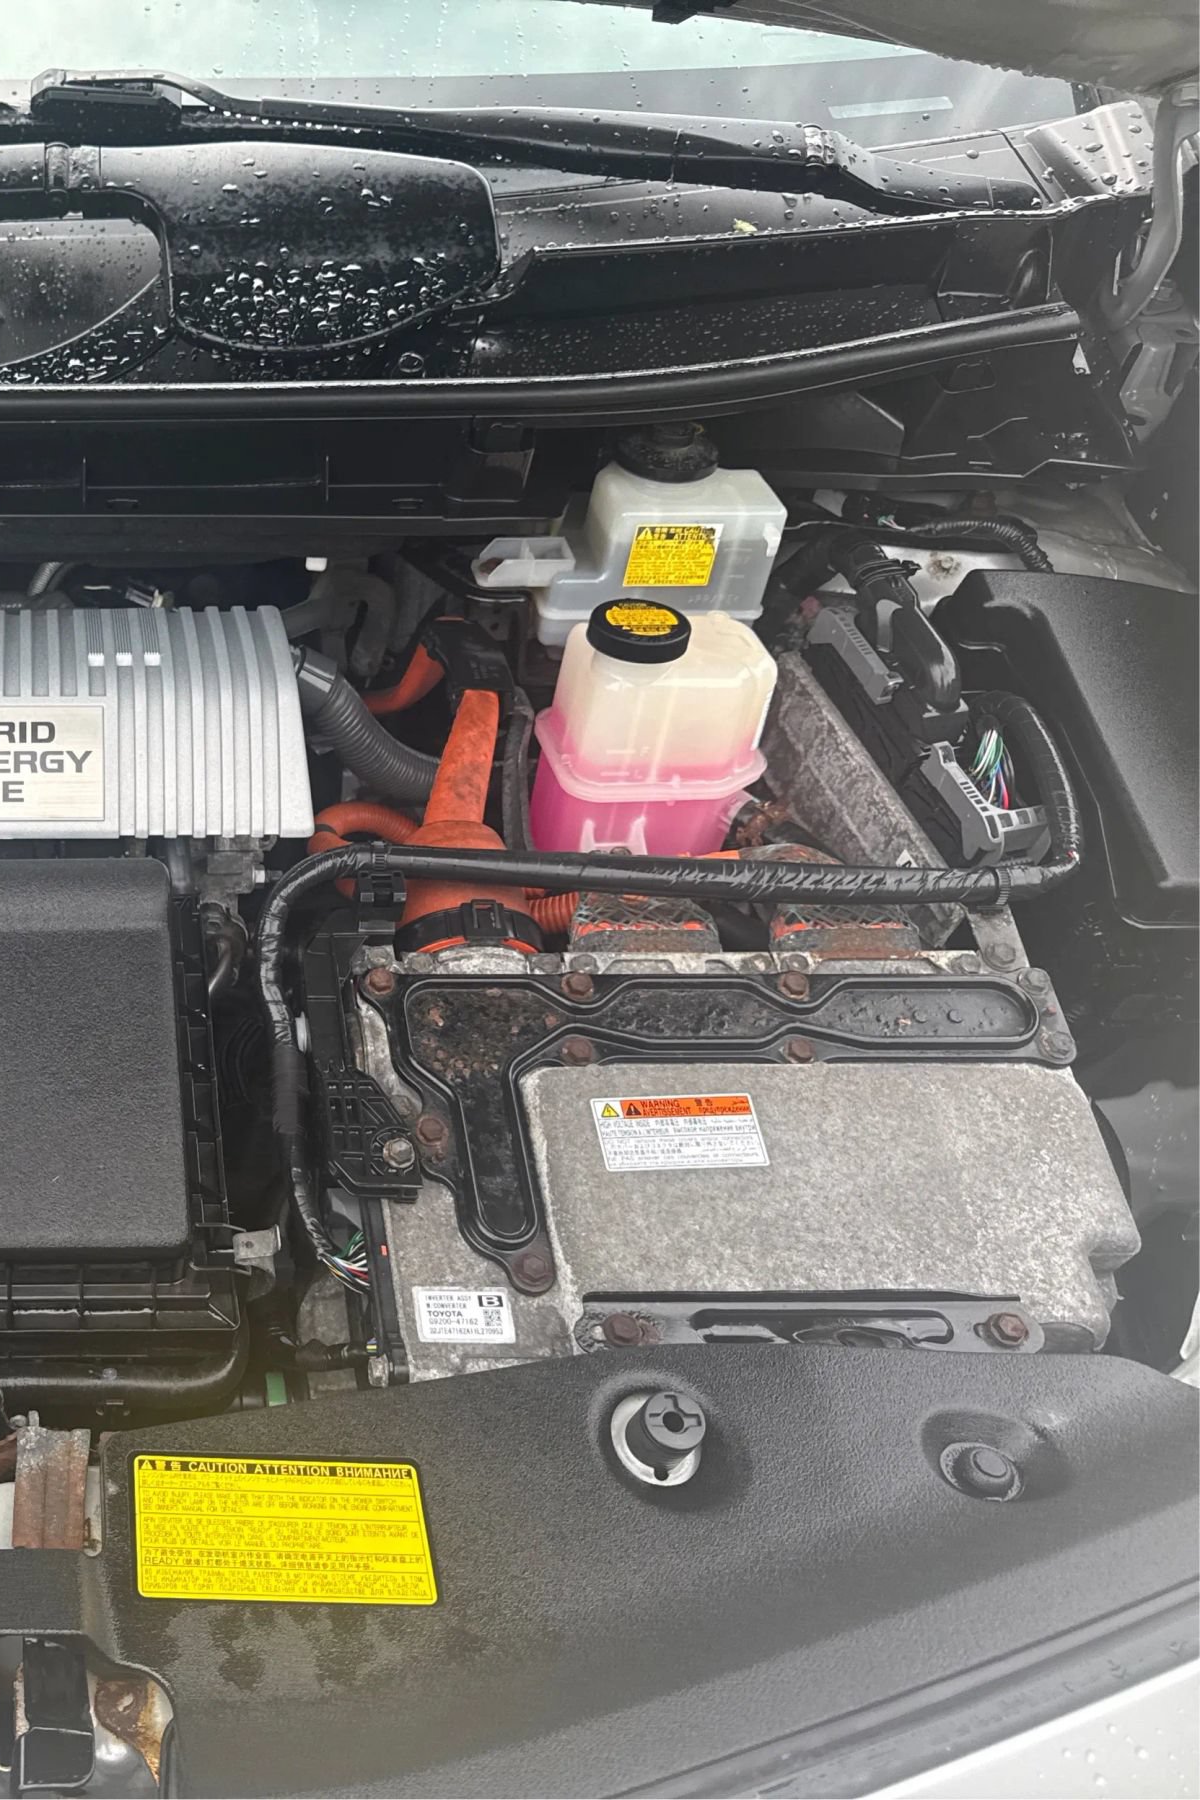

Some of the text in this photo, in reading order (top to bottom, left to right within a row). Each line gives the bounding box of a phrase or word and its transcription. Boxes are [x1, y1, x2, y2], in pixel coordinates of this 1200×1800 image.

[640, 1100, 680, 1108] WARNING
[481, 1296, 500, 1306] B
[188, 1461, 329, 1476] CAUTION ATTENTION
[335, 1467, 409, 1479] ВНИМАНИЕ
[144, 1556, 179, 1564] READY
